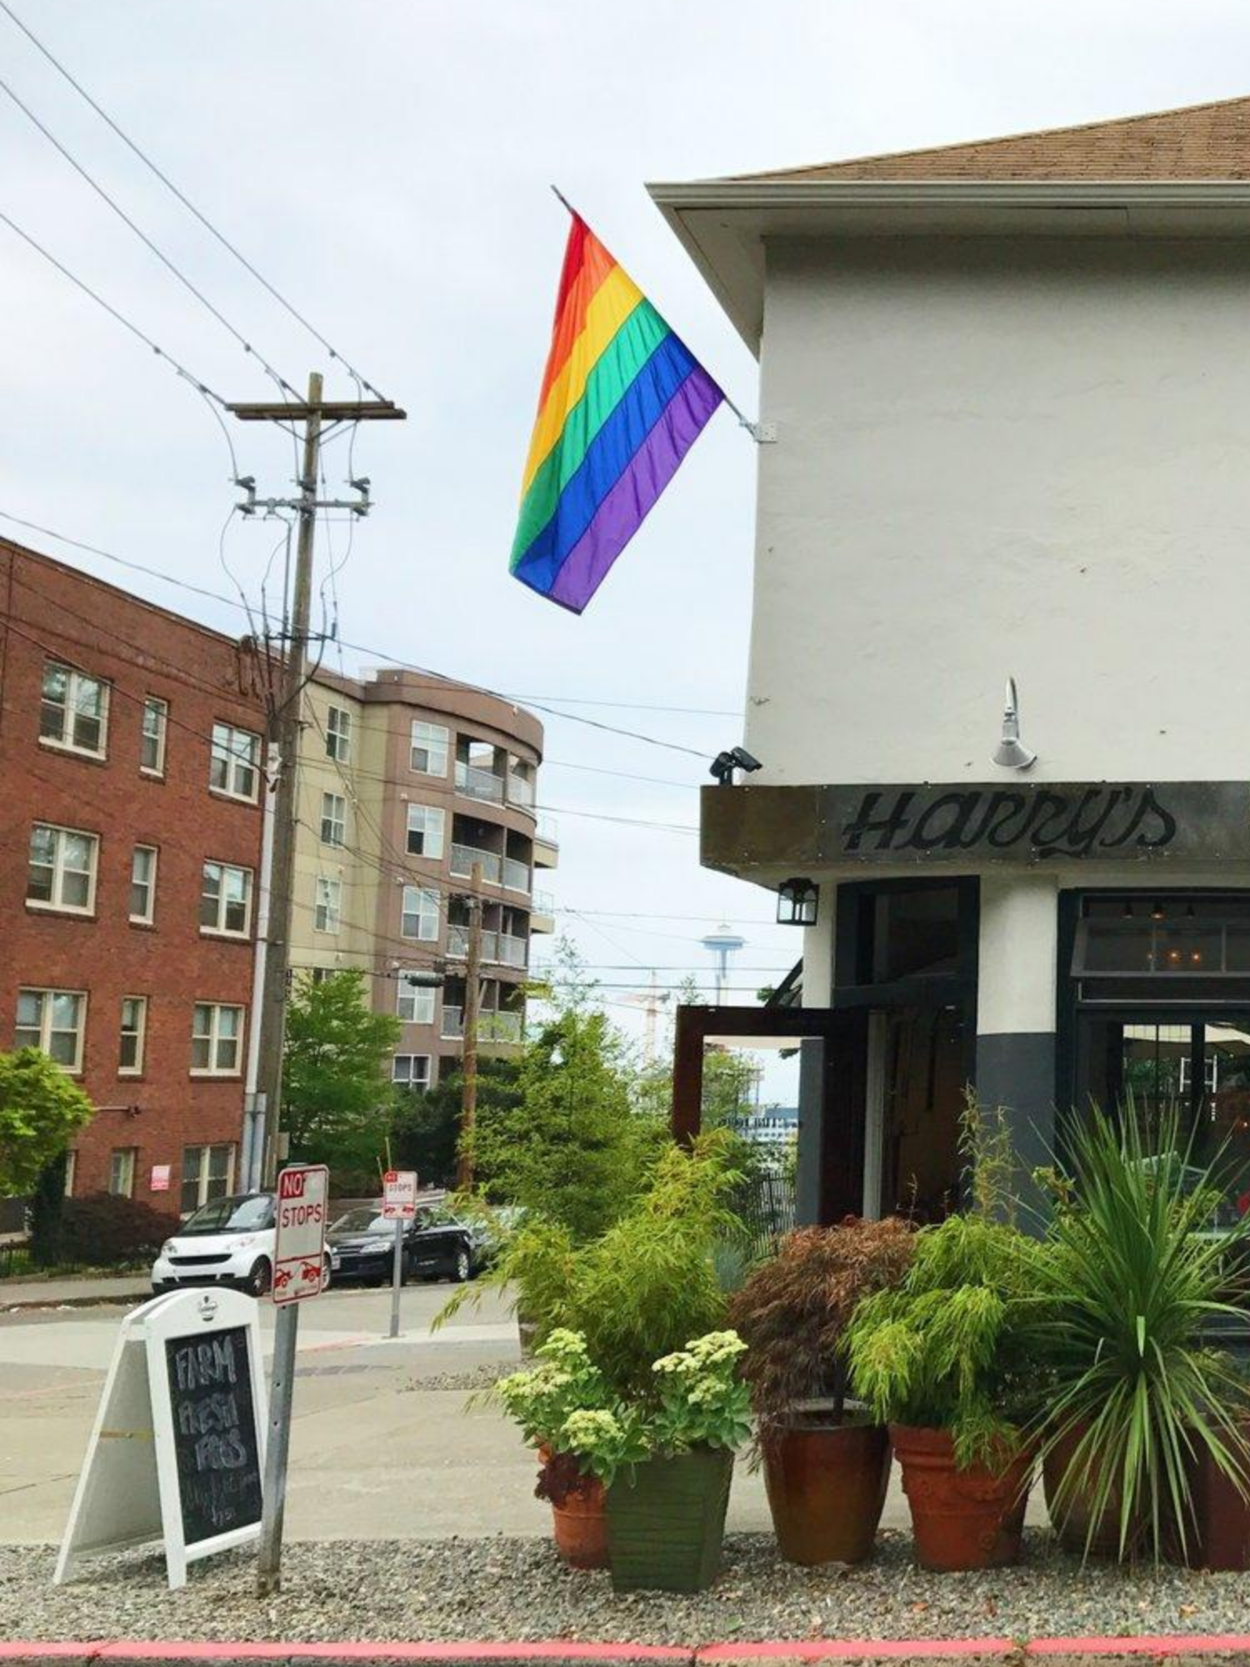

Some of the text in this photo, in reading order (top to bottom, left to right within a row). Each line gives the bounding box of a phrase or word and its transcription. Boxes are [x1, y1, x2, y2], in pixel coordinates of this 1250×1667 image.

[842, 786, 1177, 858] Harry's
[282, 1173, 302, 1197] NO
[282, 1204, 322, 1228] STOPS
[176, 1335, 237, 1391] FARM
